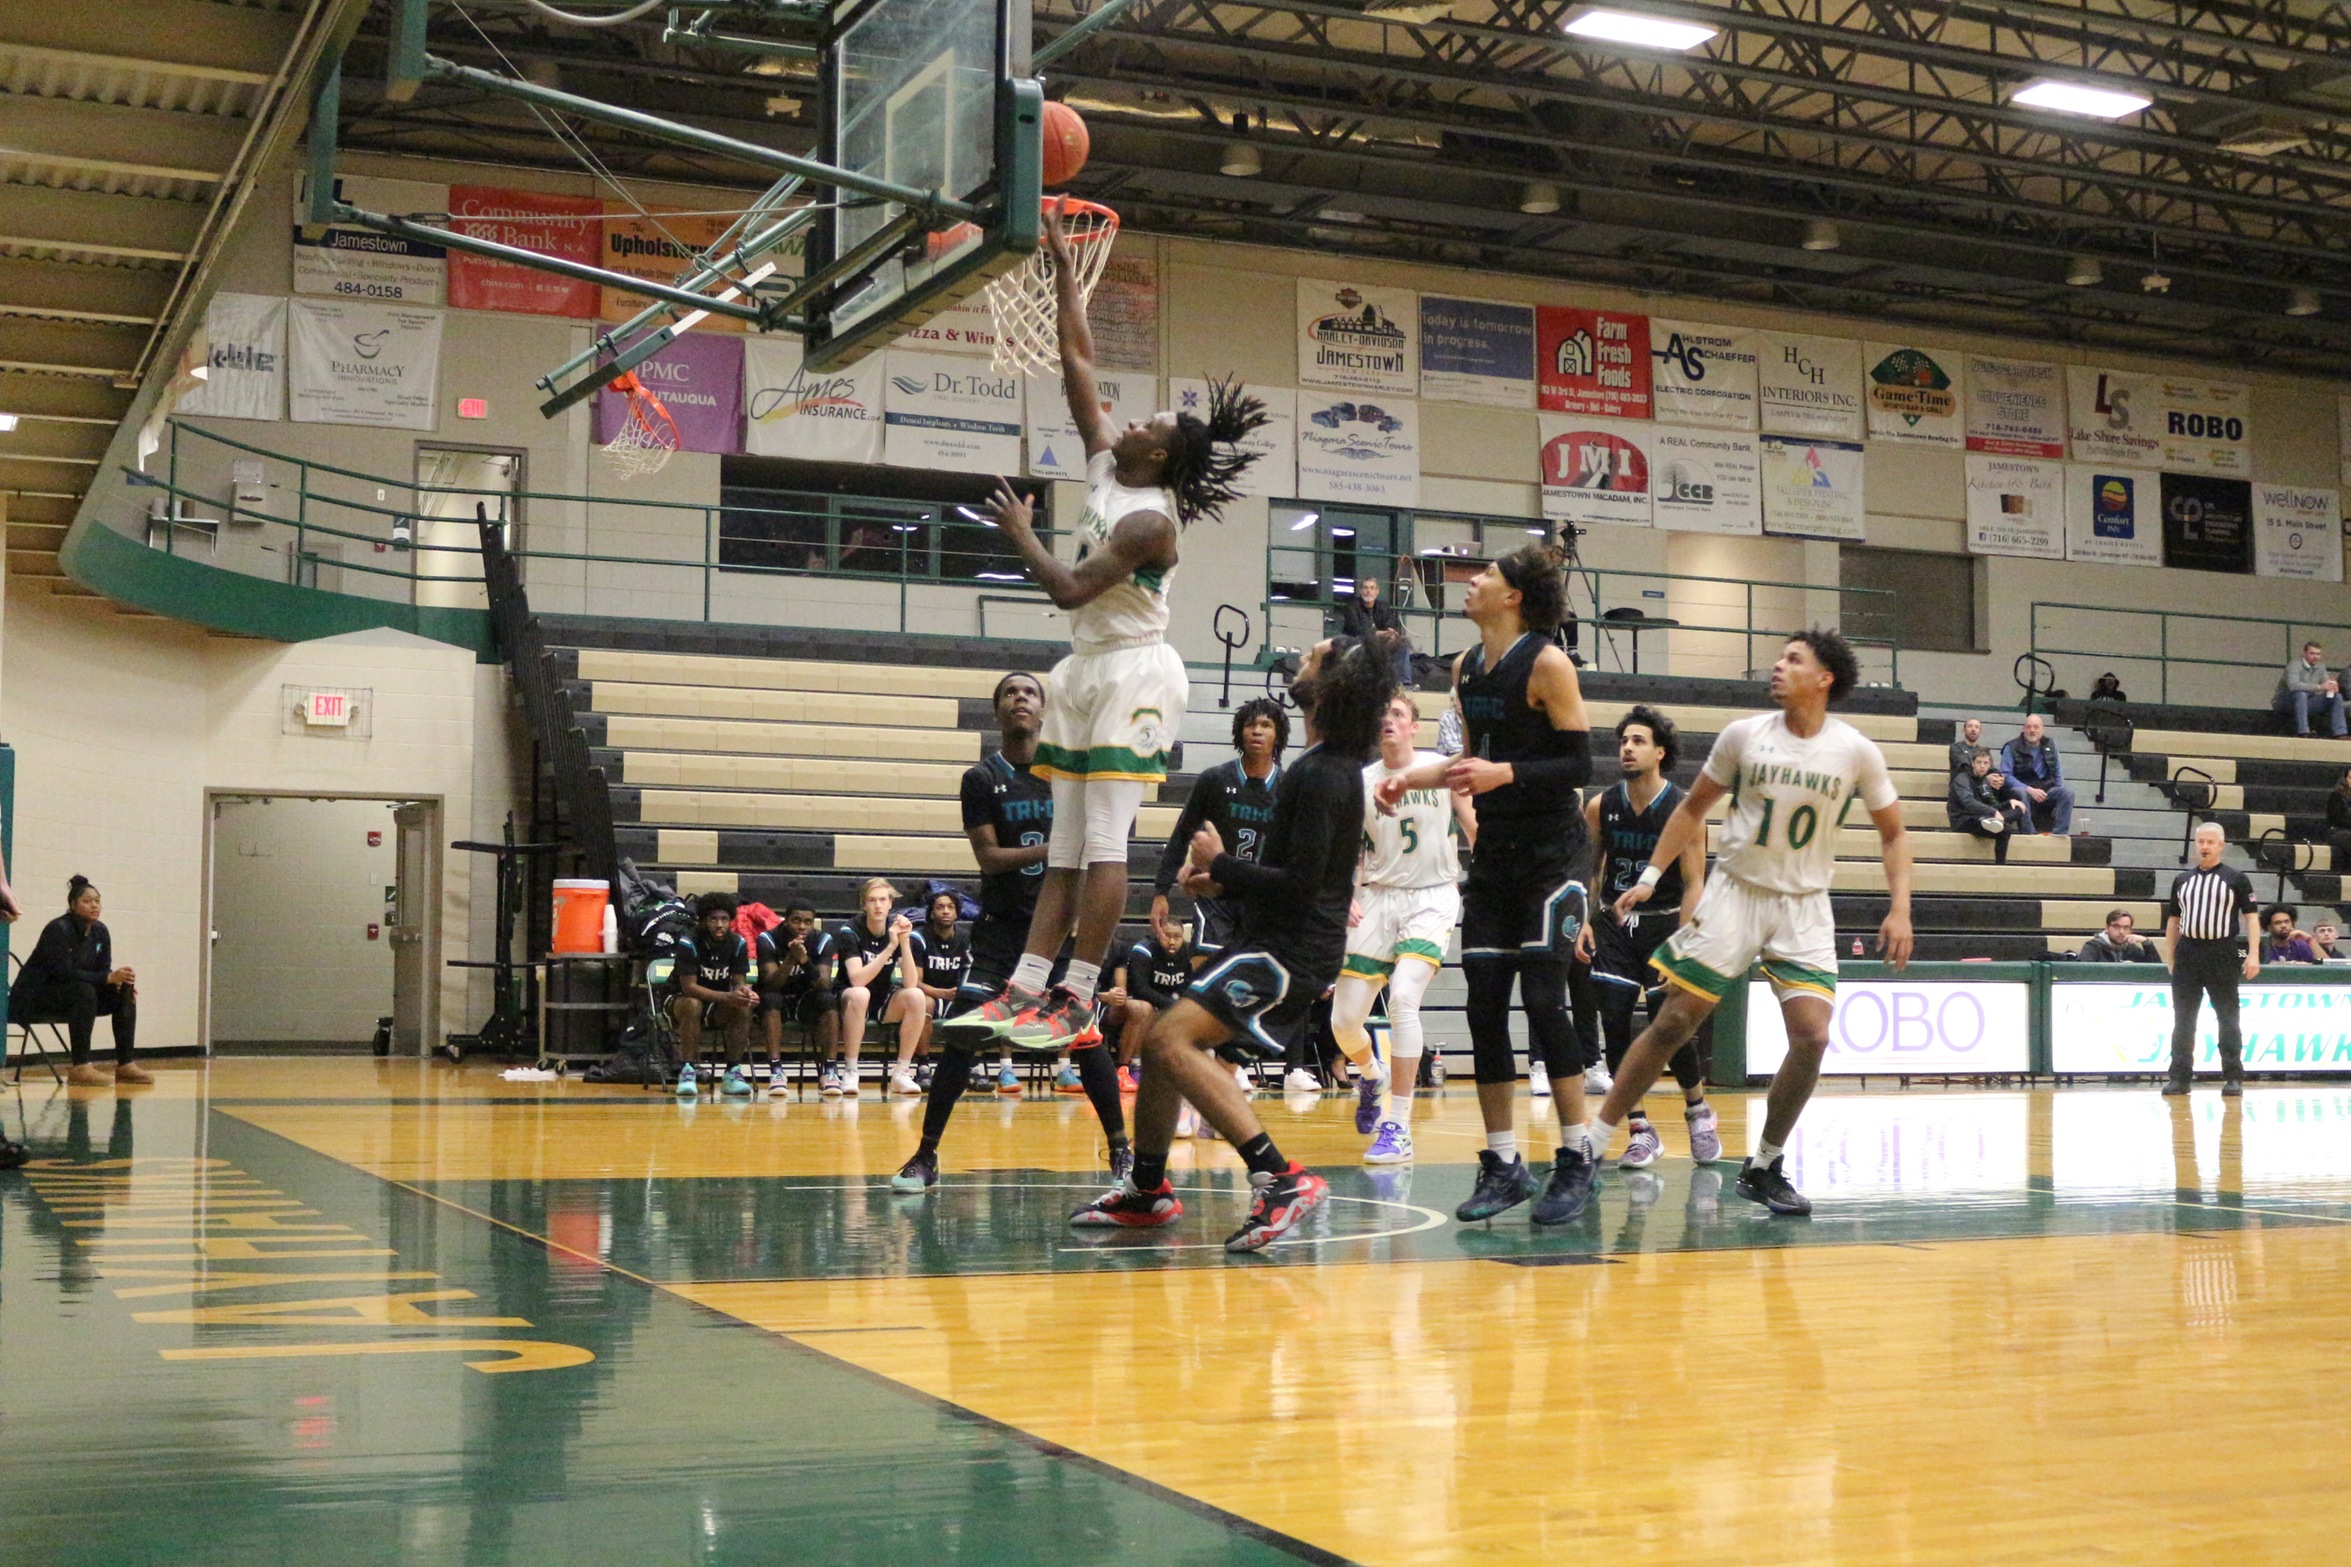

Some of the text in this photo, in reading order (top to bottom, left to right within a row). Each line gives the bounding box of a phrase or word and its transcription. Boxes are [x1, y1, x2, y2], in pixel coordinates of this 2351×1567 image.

[461, 199, 590, 236] Community
[332, 231, 408, 253] Jamestown
[503, 225, 558, 251] Bank
[372, 259, 413, 272] Windows
[416, 262, 444, 274] Doors
[334, 281, 403, 299] 484-0158
[1422, 312, 1532, 336] Today is tomorrow
[1597, 316, 1627, 341] Farm
[908, 328, 1015, 347] izza & Wins
[1317, 330, 1404, 349] HARLEY-DAVIDSON
[1424, 332, 1434, 345] in
[1316, 345, 1404, 373] JAMESTOWN
[1597, 342, 1632, 365] Fresh
[331, 360, 405, 378] PHARMACY
[1598, 364, 1631, 388] Foods
[337, 375, 398, 386] INNOVATIONS
[750, 361, 855, 420] Ames
[934, 372, 1016, 399] Dr. Todd
[1655, 385, 1752, 401] ELECTRIC CORPORATION
[1763, 386, 1858, 408] INTERIORS INC.
[1996, 406, 2030, 421] STORE
[2168, 410, 2243, 441] ROBO
[1302, 430, 1413, 451] Niagara Scenic Tours
[1660, 437, 1667, 445] A
[1667, 436, 1689, 448] REAL
[1690, 439, 1731, 452] Community
[2069, 428, 2092, 442] Lake
[2093, 430, 2121, 446] Shore
[2122, 434, 2160, 451] Savings
[1302, 466, 1412, 482] www.niagarascenictours.net
[1988, 462, 2040, 473] JAMESTOWN
[1678, 483, 1714, 500] CCB
[1968, 477, 2054, 491] Kitchen Bath
[1543, 489, 1592, 500] JAMESTOWN
[2097, 513, 2130, 526] Comfort
[2266, 517, 2275, 527] 15
[2286, 520, 2303, 529] Main
[2305, 521, 2328, 531] Street
[1989, 534, 2050, 547] (716) 665-2299
[315, 695, 343, 717] EXIT
[1750, 762, 1842, 800] JAYHAWKS
[1755, 797, 1817, 851] 10
[1400, 816, 1419, 854] 5
[928, 955, 961, 970] TRI-C
[1828, 990, 1986, 1054] OBO
